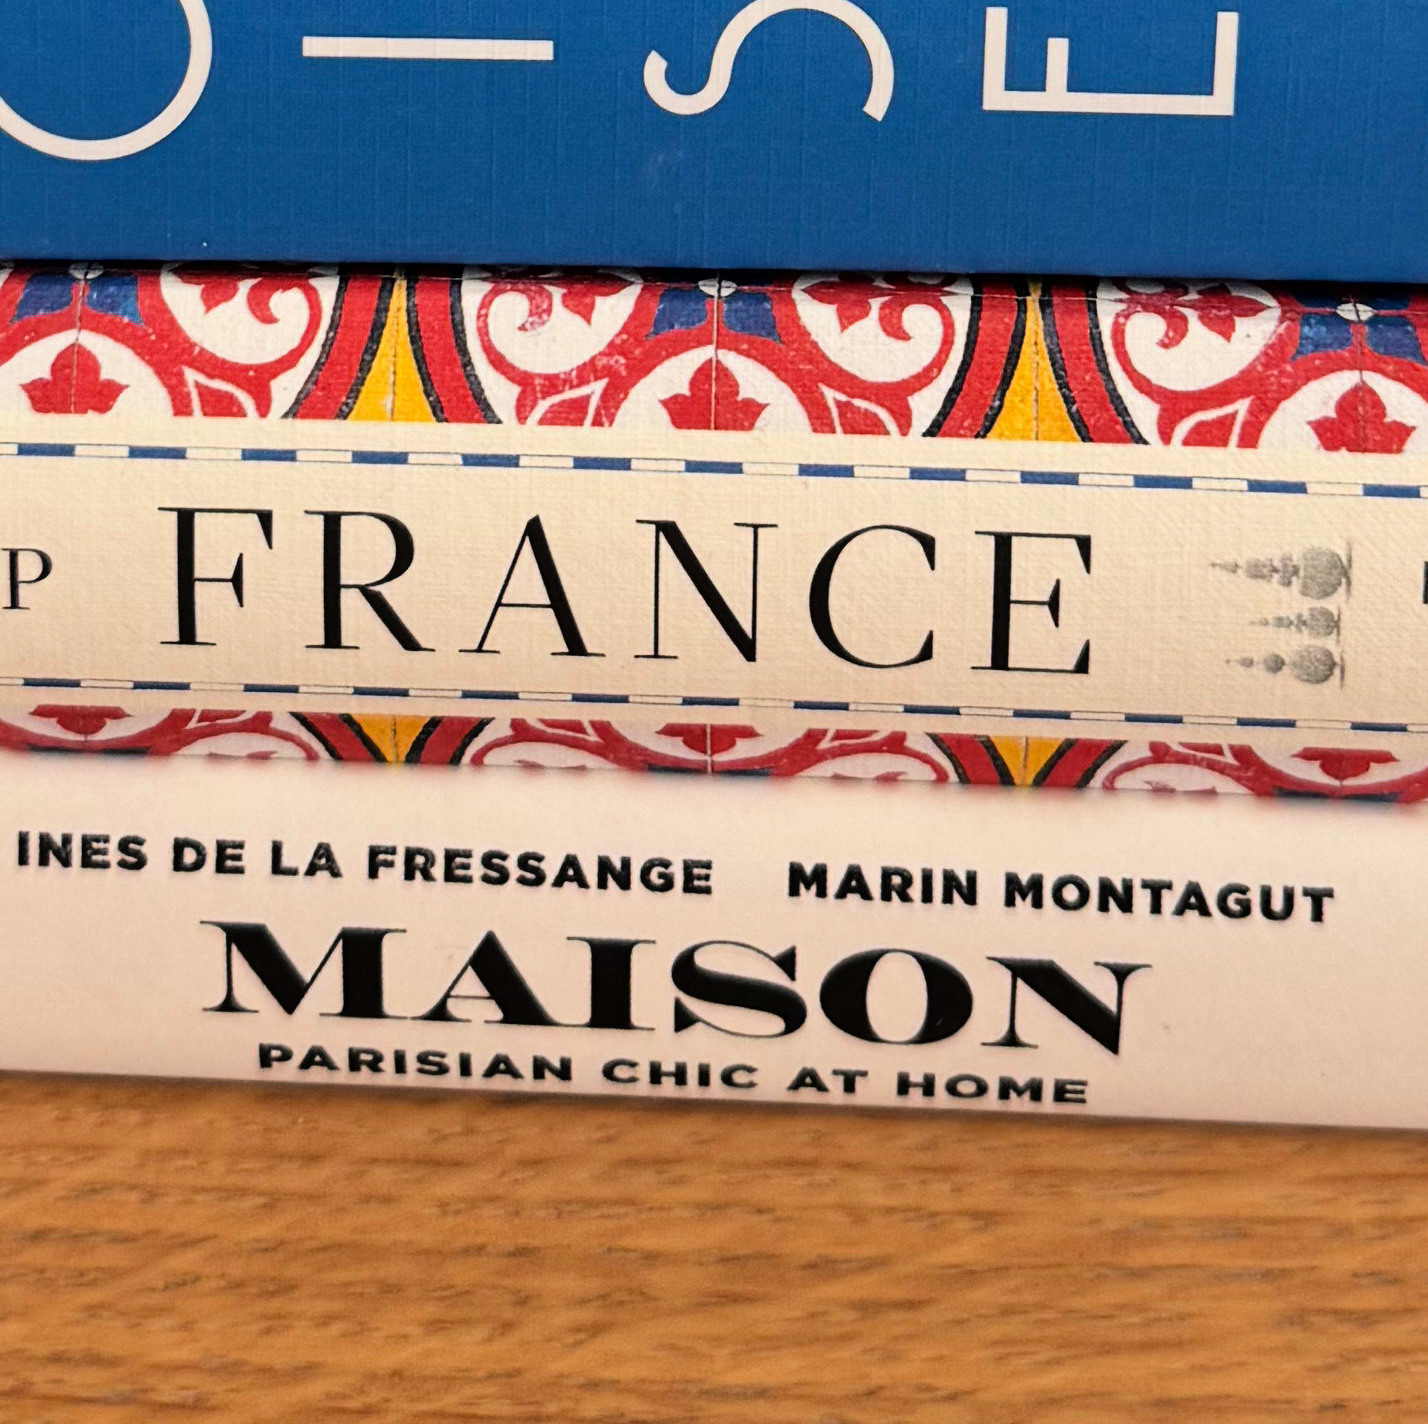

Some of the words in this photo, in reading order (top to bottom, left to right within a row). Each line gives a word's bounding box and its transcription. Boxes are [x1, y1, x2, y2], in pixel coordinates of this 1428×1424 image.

[157, 505, 1093, 673] FRANCE
[17, 831, 148, 871] INES
[172, 837, 246, 875] DE
[270, 840, 343, 880] LA
[368, 844, 714, 895] FRESSANGE
[788, 861, 978, 907] MARIN
[1003, 871, 1336, 924] MONTAGUT
[199, 919, 1154, 1056] MAISON
[258, 1043, 573, 1083] PARISIAN
[601, 1057, 759, 1090] CHIC
[785, 1065, 868, 1095] AT
[897, 1070, 1089, 1104] HOME
